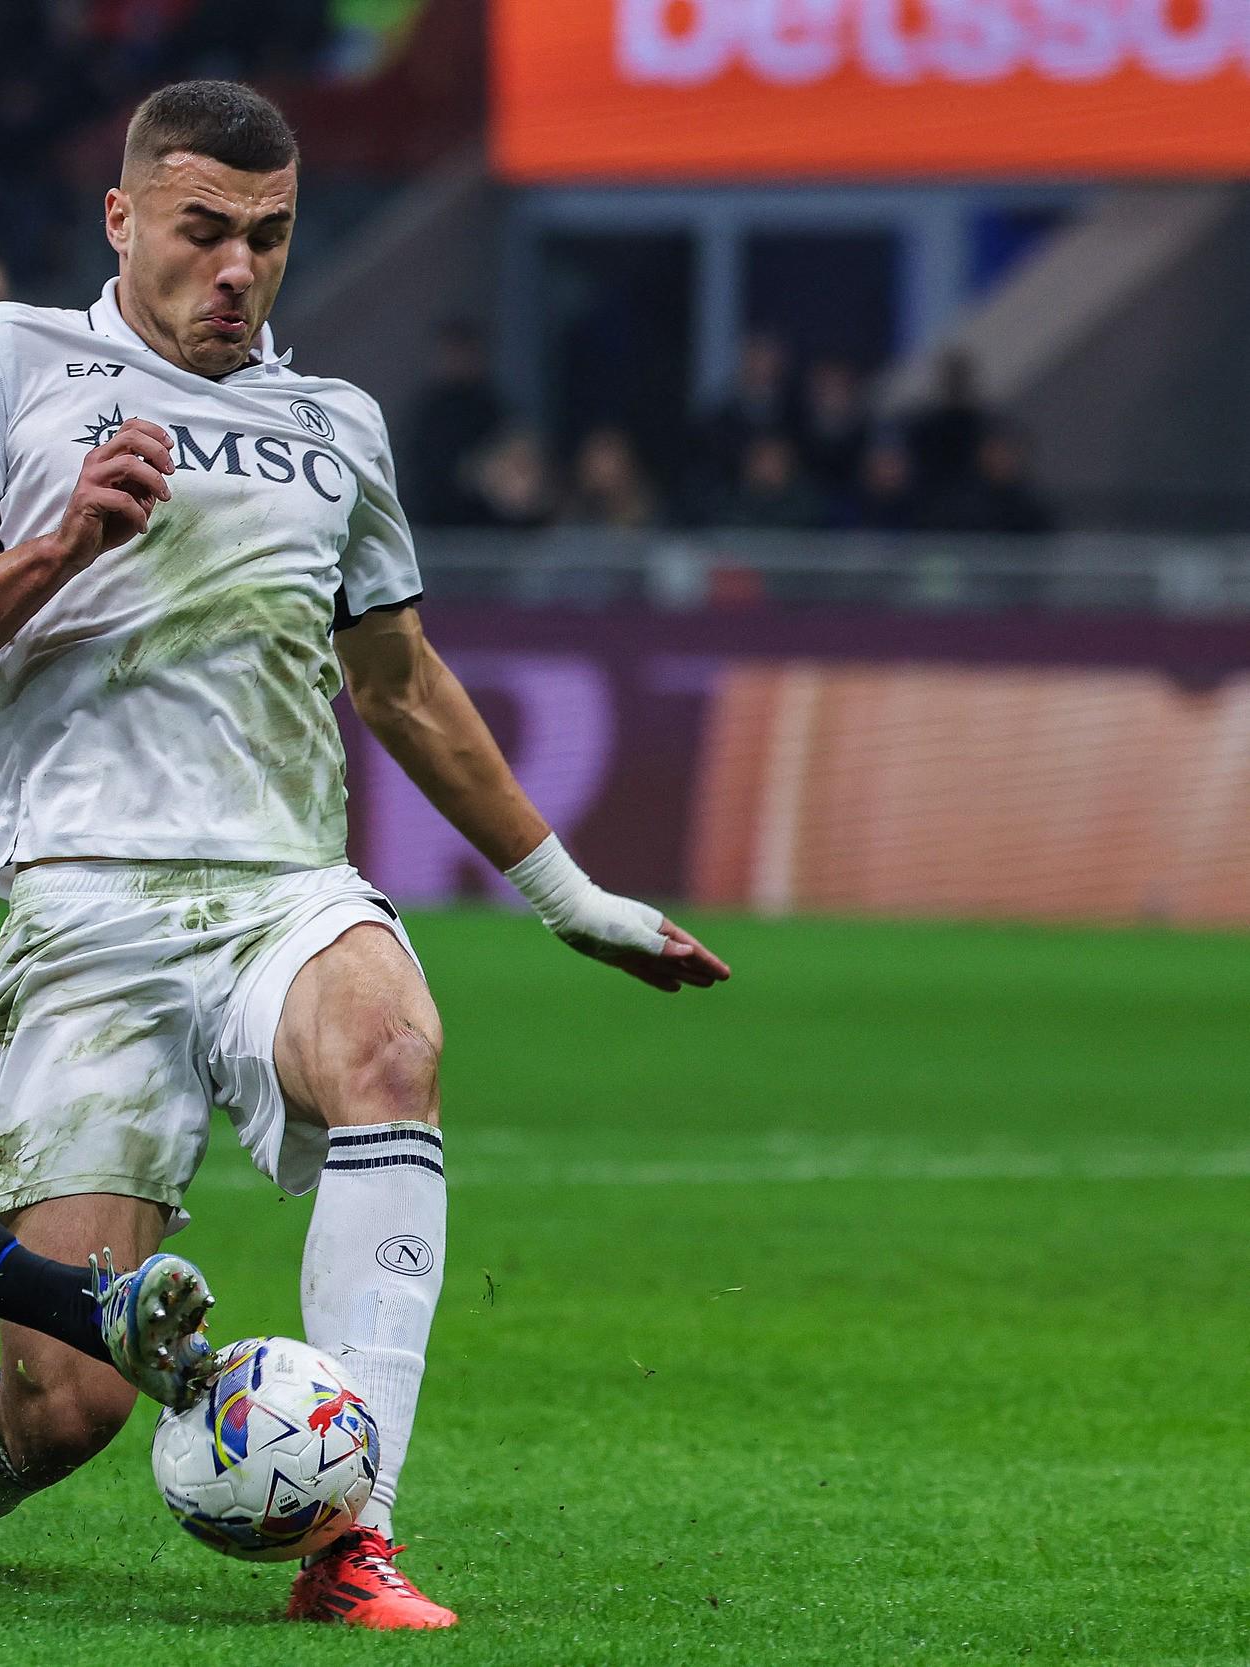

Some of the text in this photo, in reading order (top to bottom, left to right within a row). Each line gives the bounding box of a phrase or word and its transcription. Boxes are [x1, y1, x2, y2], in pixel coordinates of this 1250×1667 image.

[614, 0, 1250, 85] betsso
[66, 363, 126, 377] EA7
[169, 424, 342, 503] MSC
[395, 1245, 422, 1266] N
